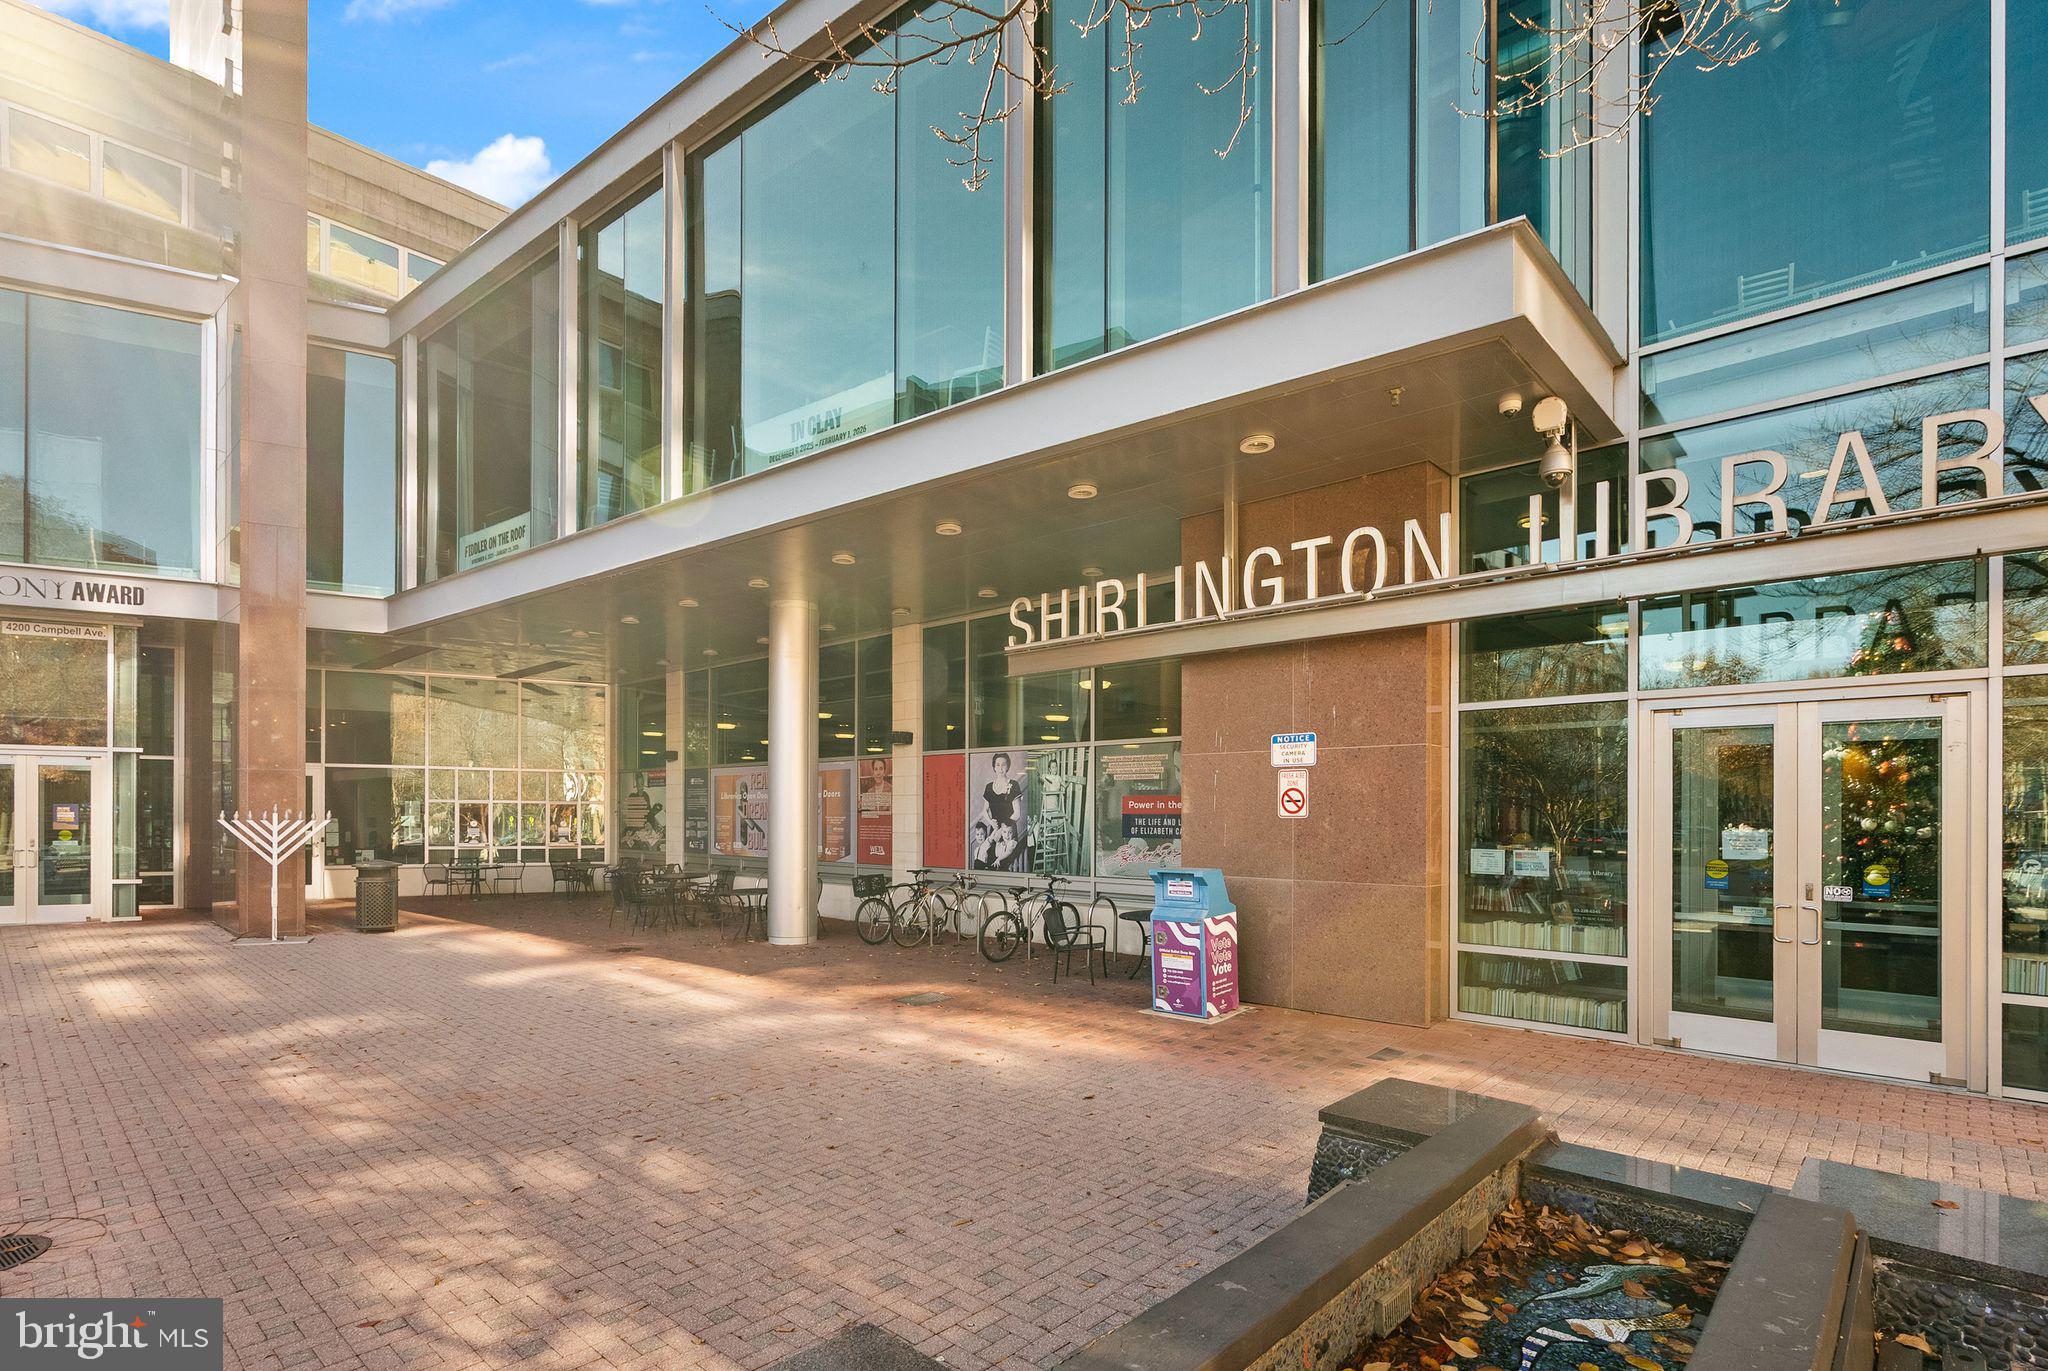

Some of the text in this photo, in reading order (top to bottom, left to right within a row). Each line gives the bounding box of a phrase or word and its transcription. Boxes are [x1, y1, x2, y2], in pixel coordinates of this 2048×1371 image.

[790, 407, 843, 443] IN CLAY
[768, 448, 795, 463] DECEMBER
[819, 431, 847, 447] FEBRUARY
[852, 424, 868, 437] 2026
[1008, 394, 2048, 648] SHIRLINGTON LIBRAR
[465, 525, 526, 558] FIDDLER ON THE ROOF
[71, 581, 146, 607] AWARD
[6, 622, 107, 638] 4200 Campbell Ave.
[1277, 734, 1310, 744] NOTICE
[750, 771, 768, 790] REA
[823, 789, 841, 798] Doors
[1128, 800, 1182, 809] Power in the
[1135, 818, 1146, 826] THE
[1148, 818, 1162, 826] LIFE
[1163, 818, 1176, 826] AND
[1130, 827, 1139, 835] OF
[1140, 827, 1174, 835] ELIZABETH
[747, 832, 768, 850] BUIL
[1592, 869, 1614, 878] Library
[1825, 887, 1841, 896] NO
[1210, 936, 1232, 952] Vote
[1210, 949, 1232, 965] Vote
[1211, 962, 1233, 977] Vote
